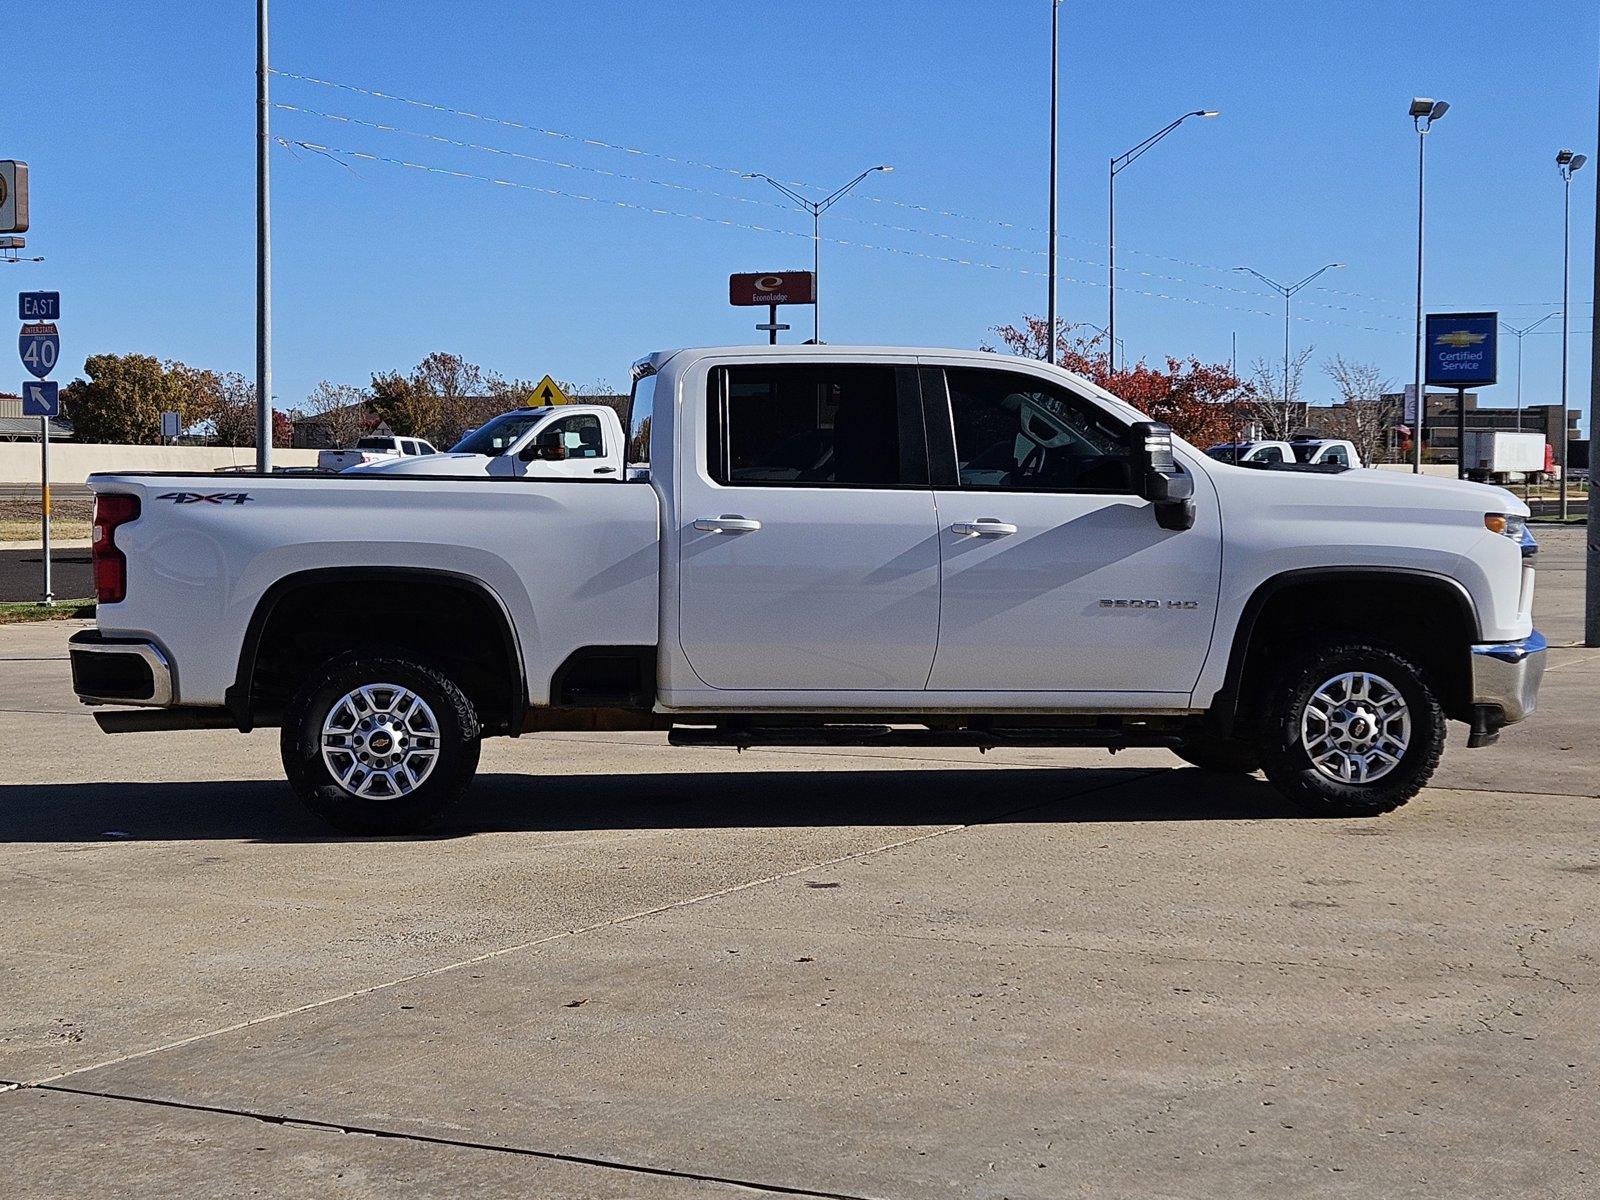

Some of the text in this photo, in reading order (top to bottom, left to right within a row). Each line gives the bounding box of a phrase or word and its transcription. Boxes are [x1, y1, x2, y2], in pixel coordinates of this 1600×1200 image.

[24, 297, 54, 315] EAST
[25, 326, 54, 334] INTERSTATE
[23, 340, 56, 369] 40
[1439, 351, 1484, 361] Certified
[1442, 361, 1480, 371] Service
[1167, 600, 1199, 610] HD
